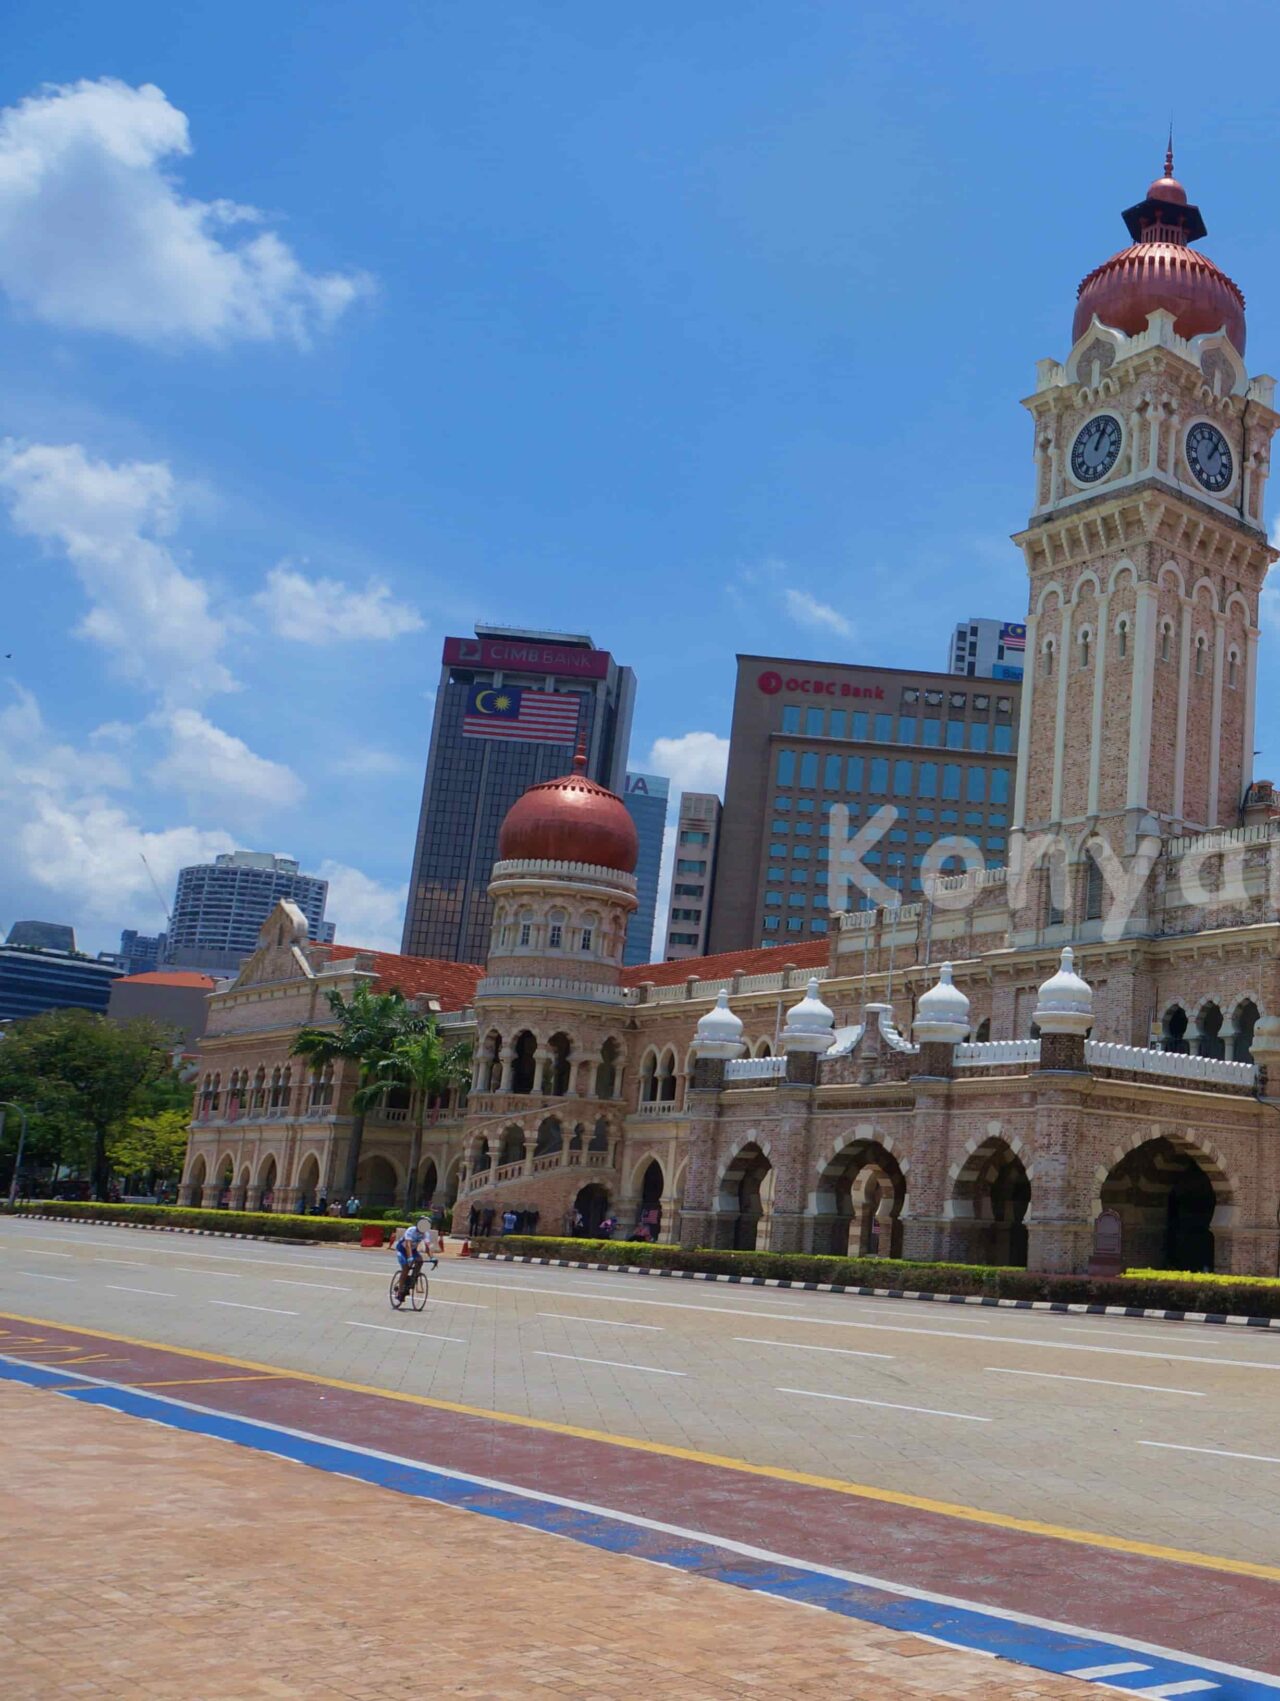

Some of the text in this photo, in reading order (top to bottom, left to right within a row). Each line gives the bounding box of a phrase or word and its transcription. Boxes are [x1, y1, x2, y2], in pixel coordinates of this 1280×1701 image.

[490, 645, 591, 668] CIMB BANK
[785, 678, 885, 700] OCBC Bank
